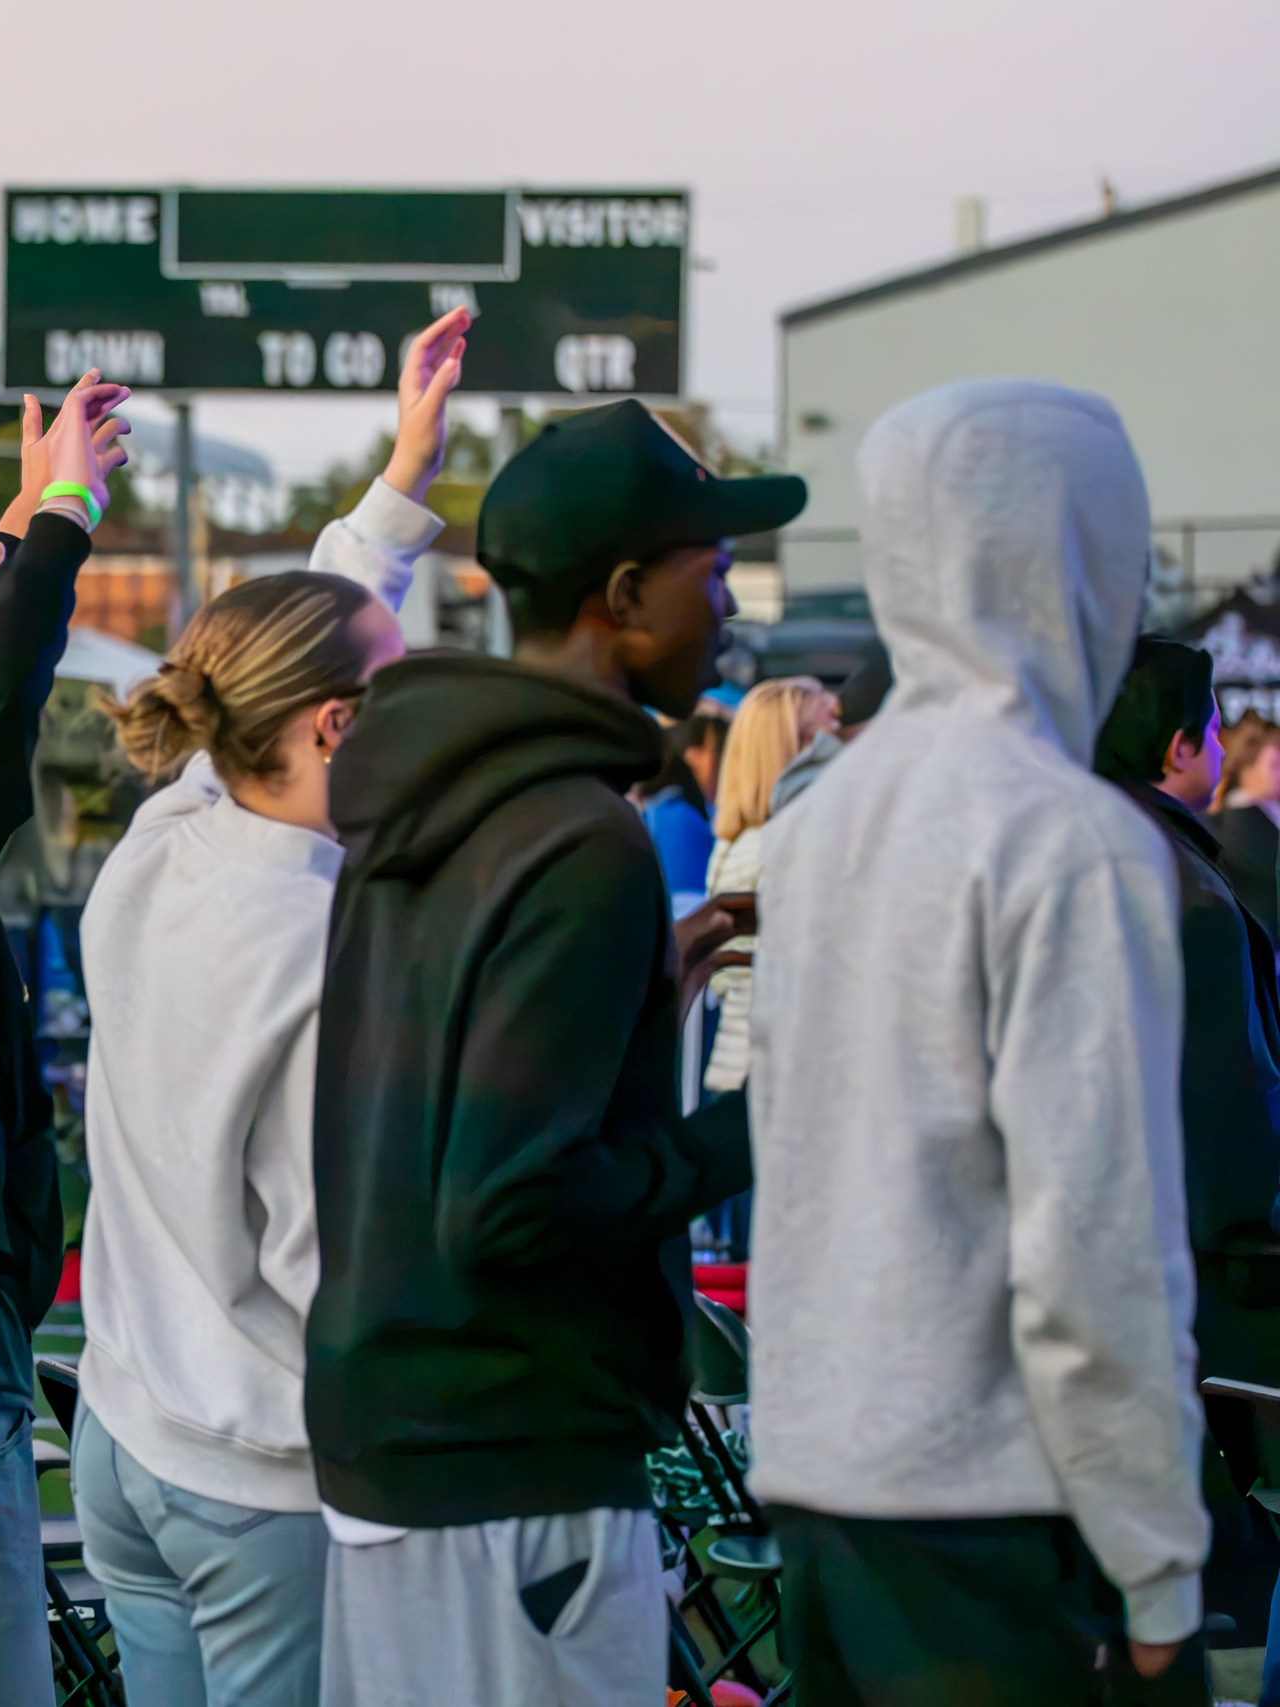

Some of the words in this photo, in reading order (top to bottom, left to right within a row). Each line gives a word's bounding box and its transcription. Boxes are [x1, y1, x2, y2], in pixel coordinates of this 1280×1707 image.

[13, 196, 157, 245] HOME
[517, 198, 689, 248] VISITOR
[45, 329, 165, 385] DOWN
[256, 331, 317, 387] TO
[323, 331, 386, 388] GO
[554, 333, 637, 393] QTR
